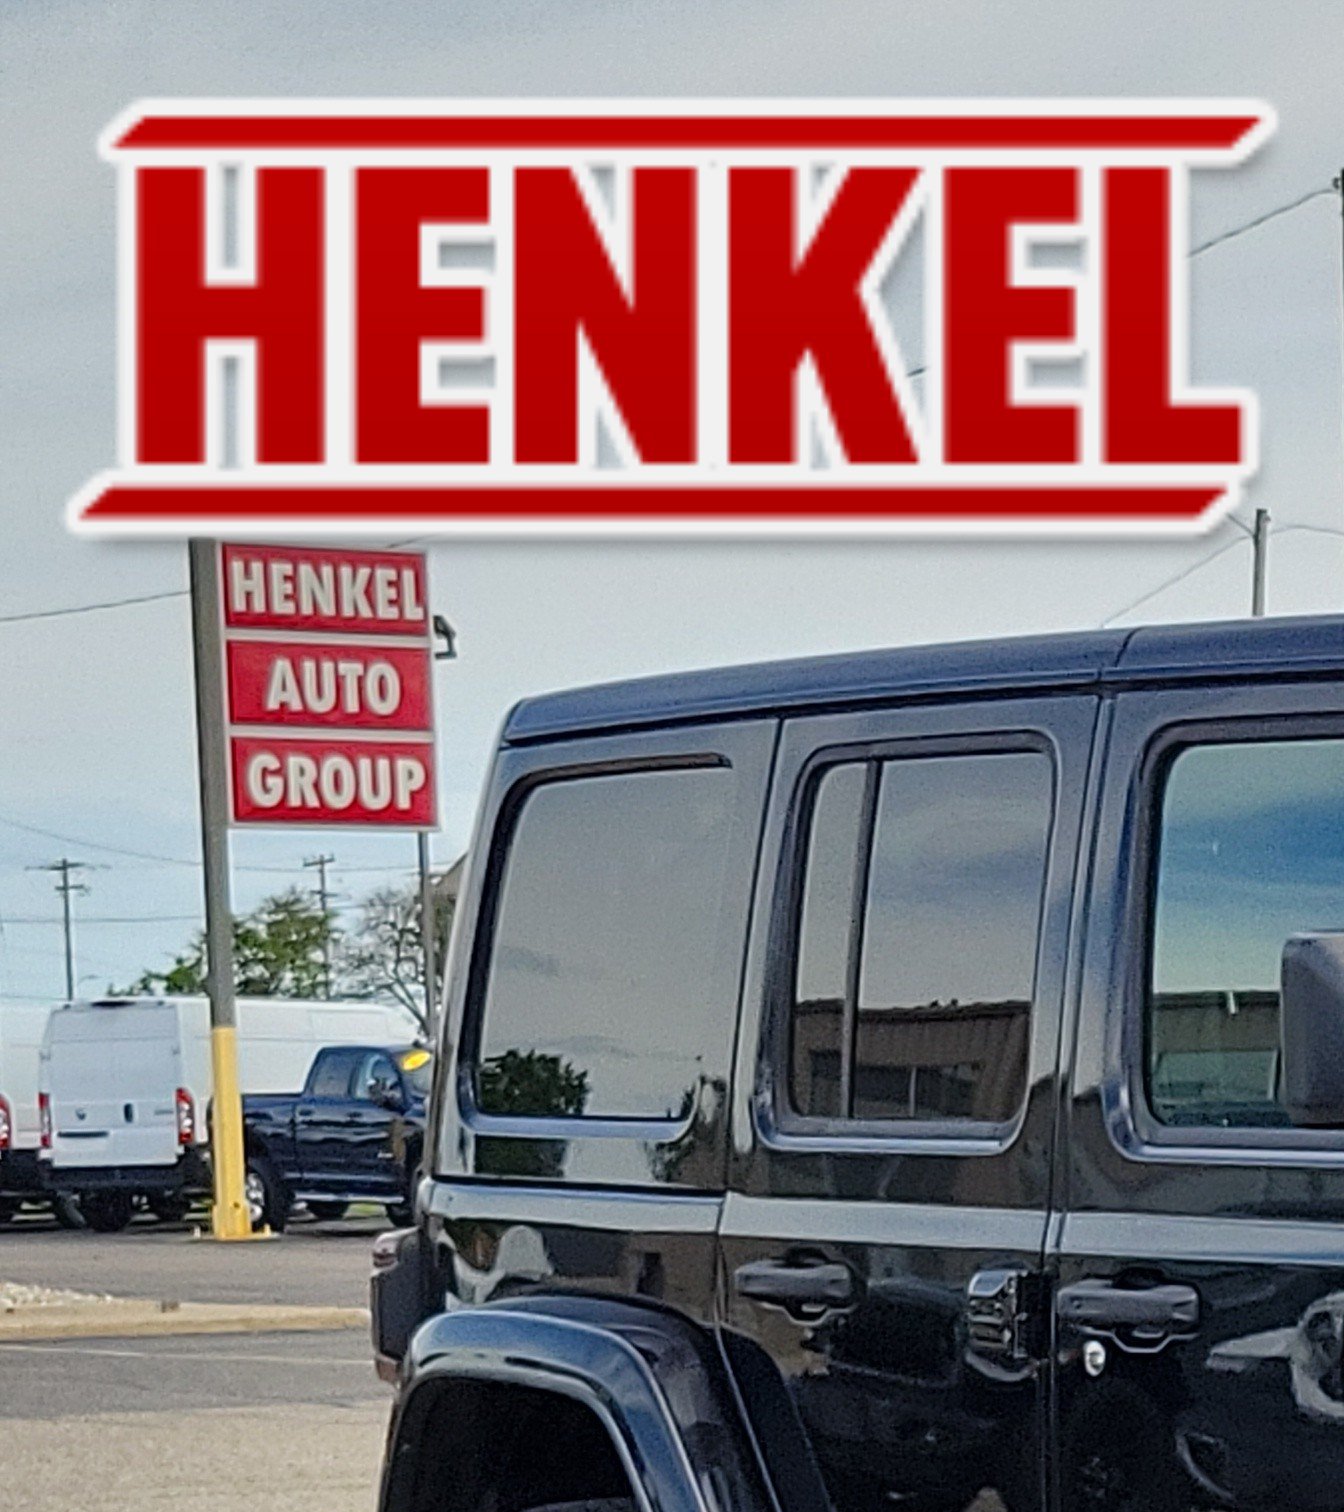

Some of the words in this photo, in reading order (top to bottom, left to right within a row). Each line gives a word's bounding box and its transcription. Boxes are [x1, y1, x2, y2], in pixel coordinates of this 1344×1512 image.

[230, 559, 425, 621] HENKEL
[265, 657, 402, 716] AUTO
[247, 752, 427, 812] GROUP
